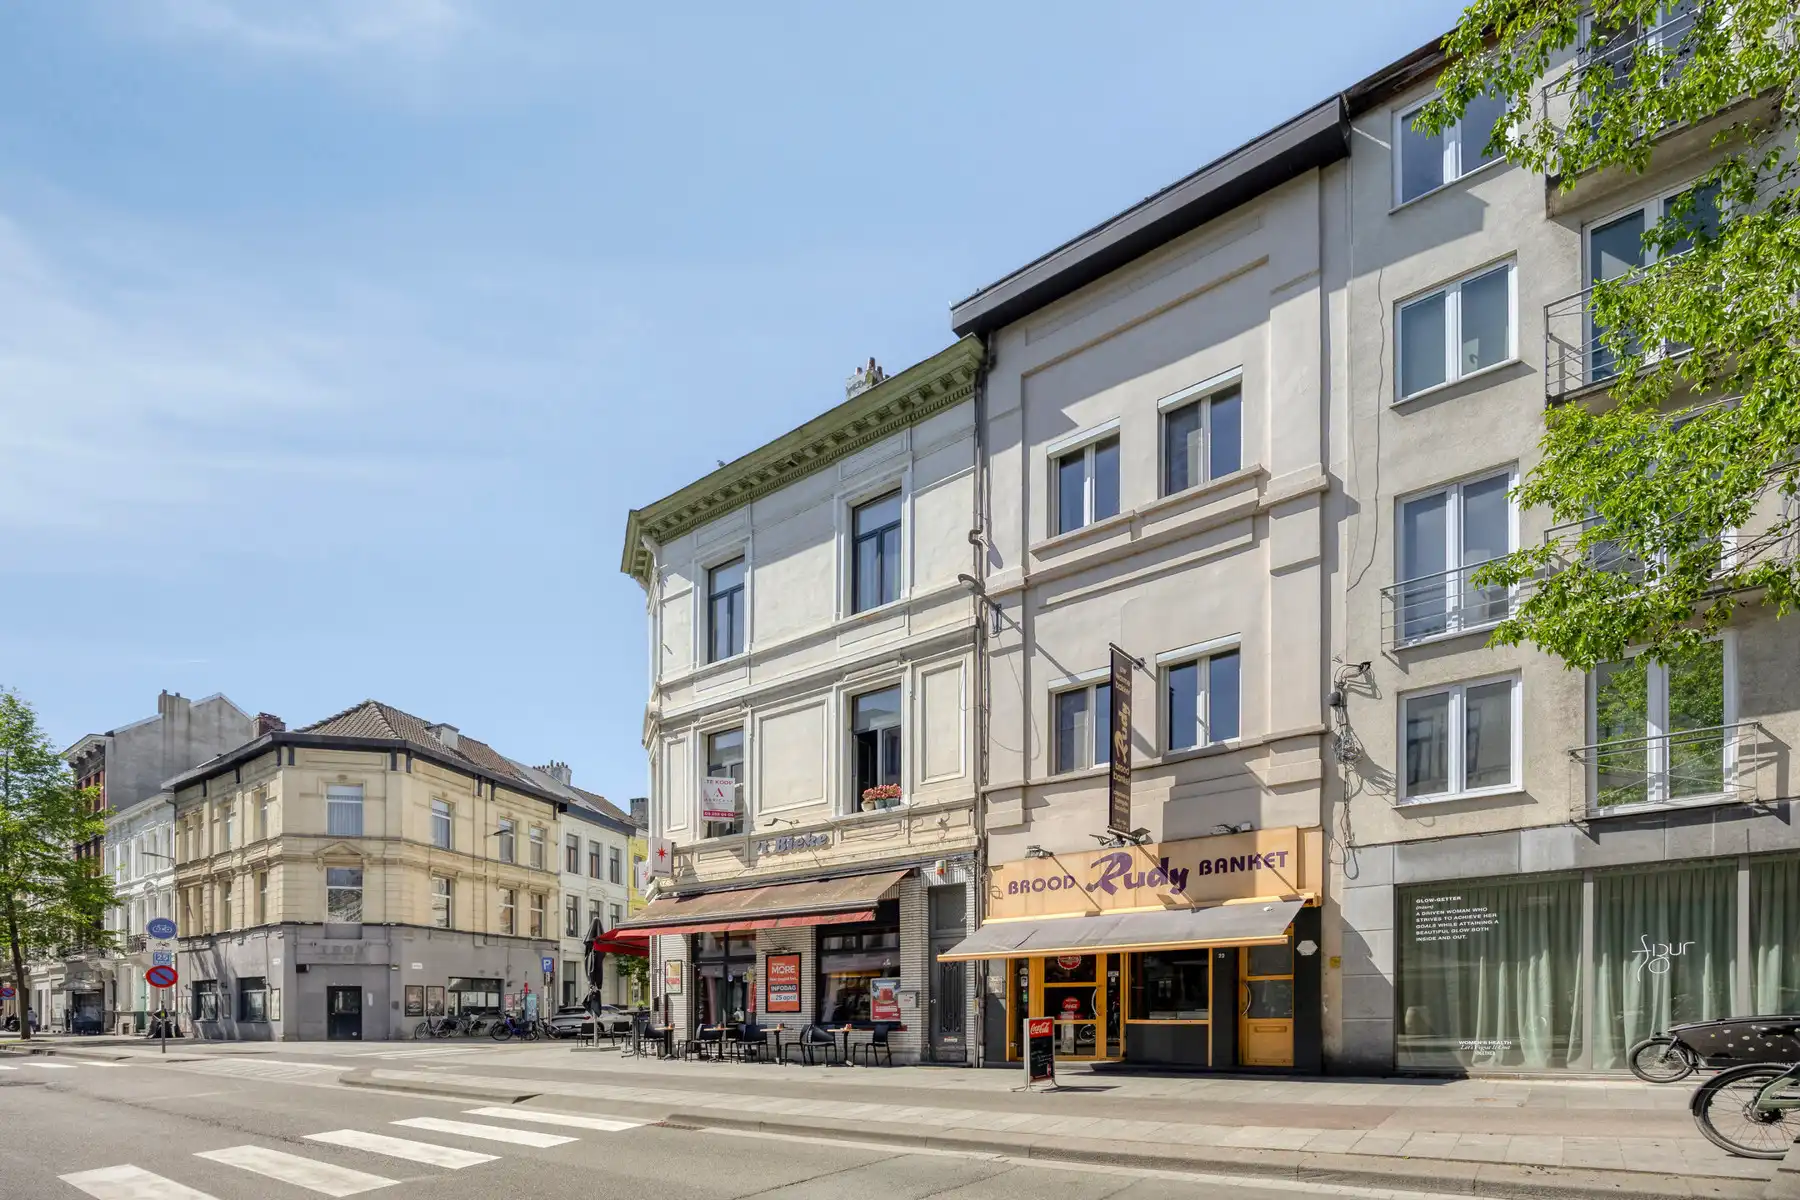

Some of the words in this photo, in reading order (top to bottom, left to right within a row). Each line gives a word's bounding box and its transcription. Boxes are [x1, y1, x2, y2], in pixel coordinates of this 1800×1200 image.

[1114, 701, 1130, 763] Rudy
[775, 832, 830, 853] Bieke
[1008, 875, 1076, 894] BROOD
[1085, 851, 1189, 896] Rudy
[1199, 850, 1289, 876] BANKET
[771, 965, 796, 974] MORE
